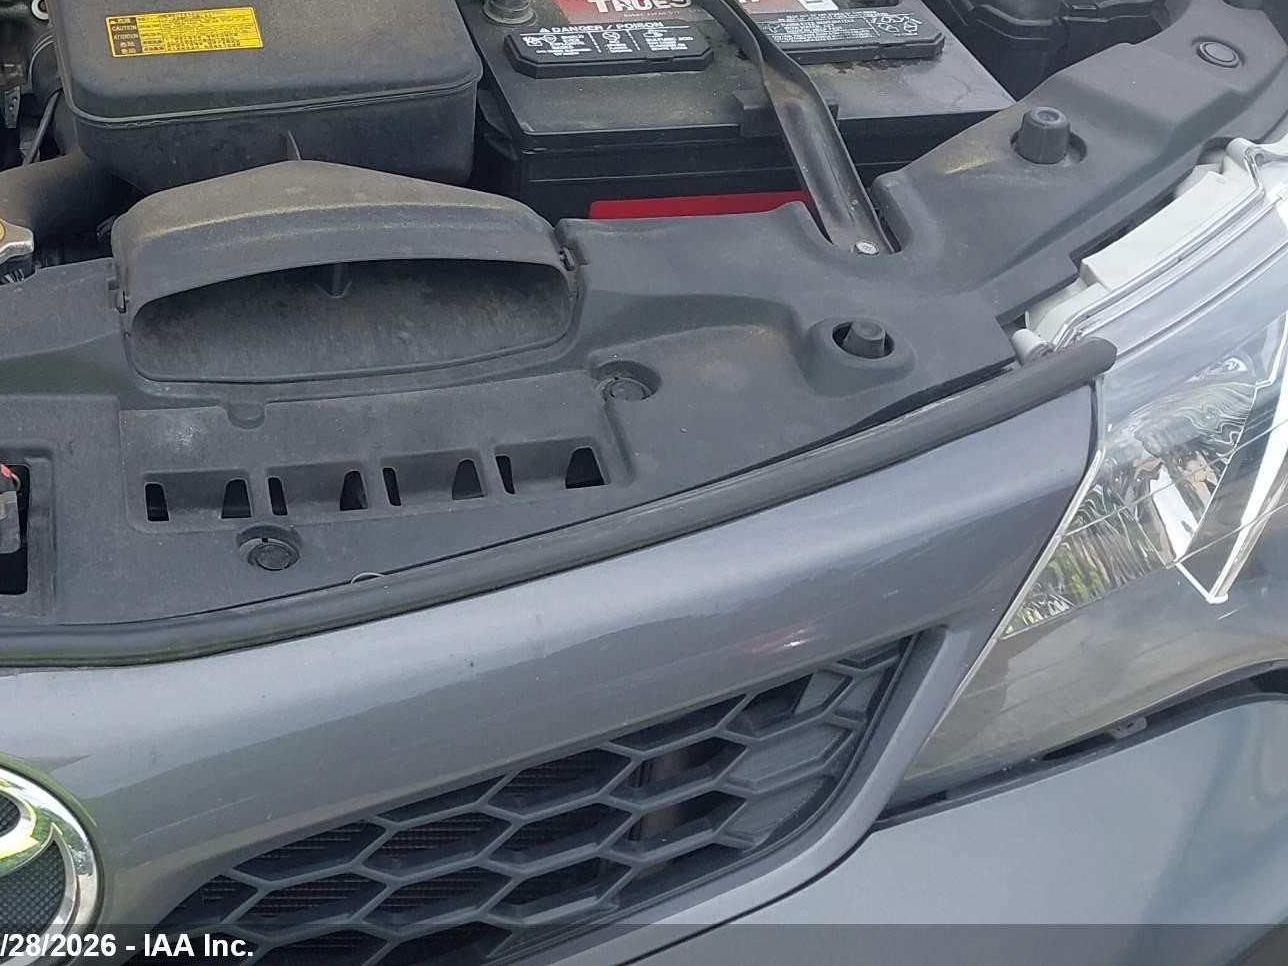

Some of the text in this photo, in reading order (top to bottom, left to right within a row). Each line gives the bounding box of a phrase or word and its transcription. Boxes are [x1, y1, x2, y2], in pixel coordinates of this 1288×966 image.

[111, 24, 137, 32] CAUTION
[551, 24, 603, 33] DANGER
[615, 21, 665, 30] POISON
